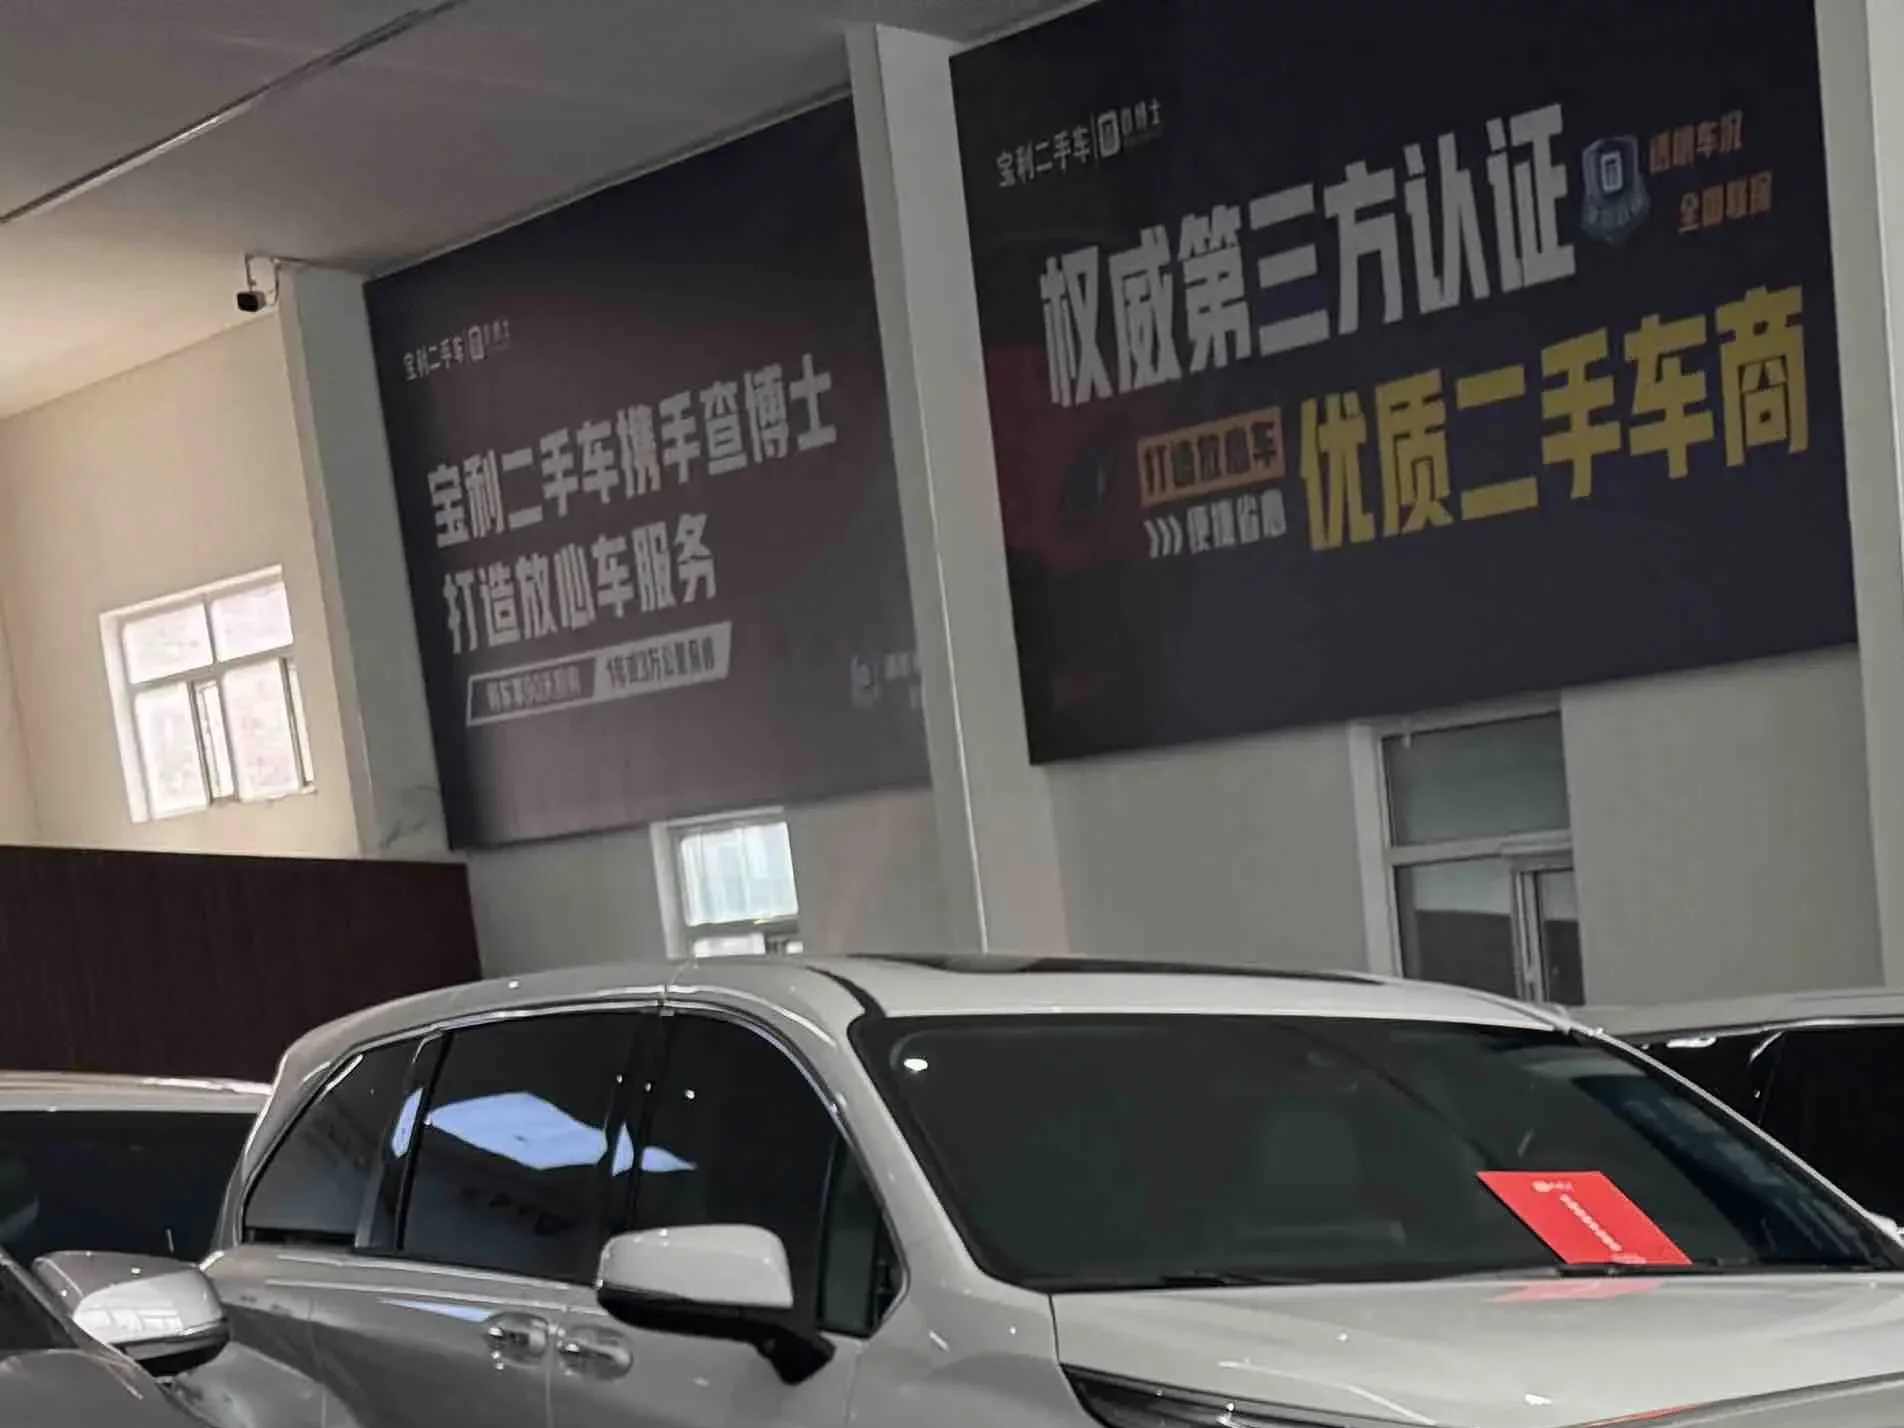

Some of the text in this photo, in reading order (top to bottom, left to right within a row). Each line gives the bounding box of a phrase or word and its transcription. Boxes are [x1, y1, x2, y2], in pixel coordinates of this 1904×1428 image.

[1040, 103, 1577, 408] 权威第三方认证
[427, 354, 837, 547] 宝利二手车携手查博士
[1300, 286, 1808, 551] 优质二手车商
[443, 513, 717, 655] 打造放心车服务
